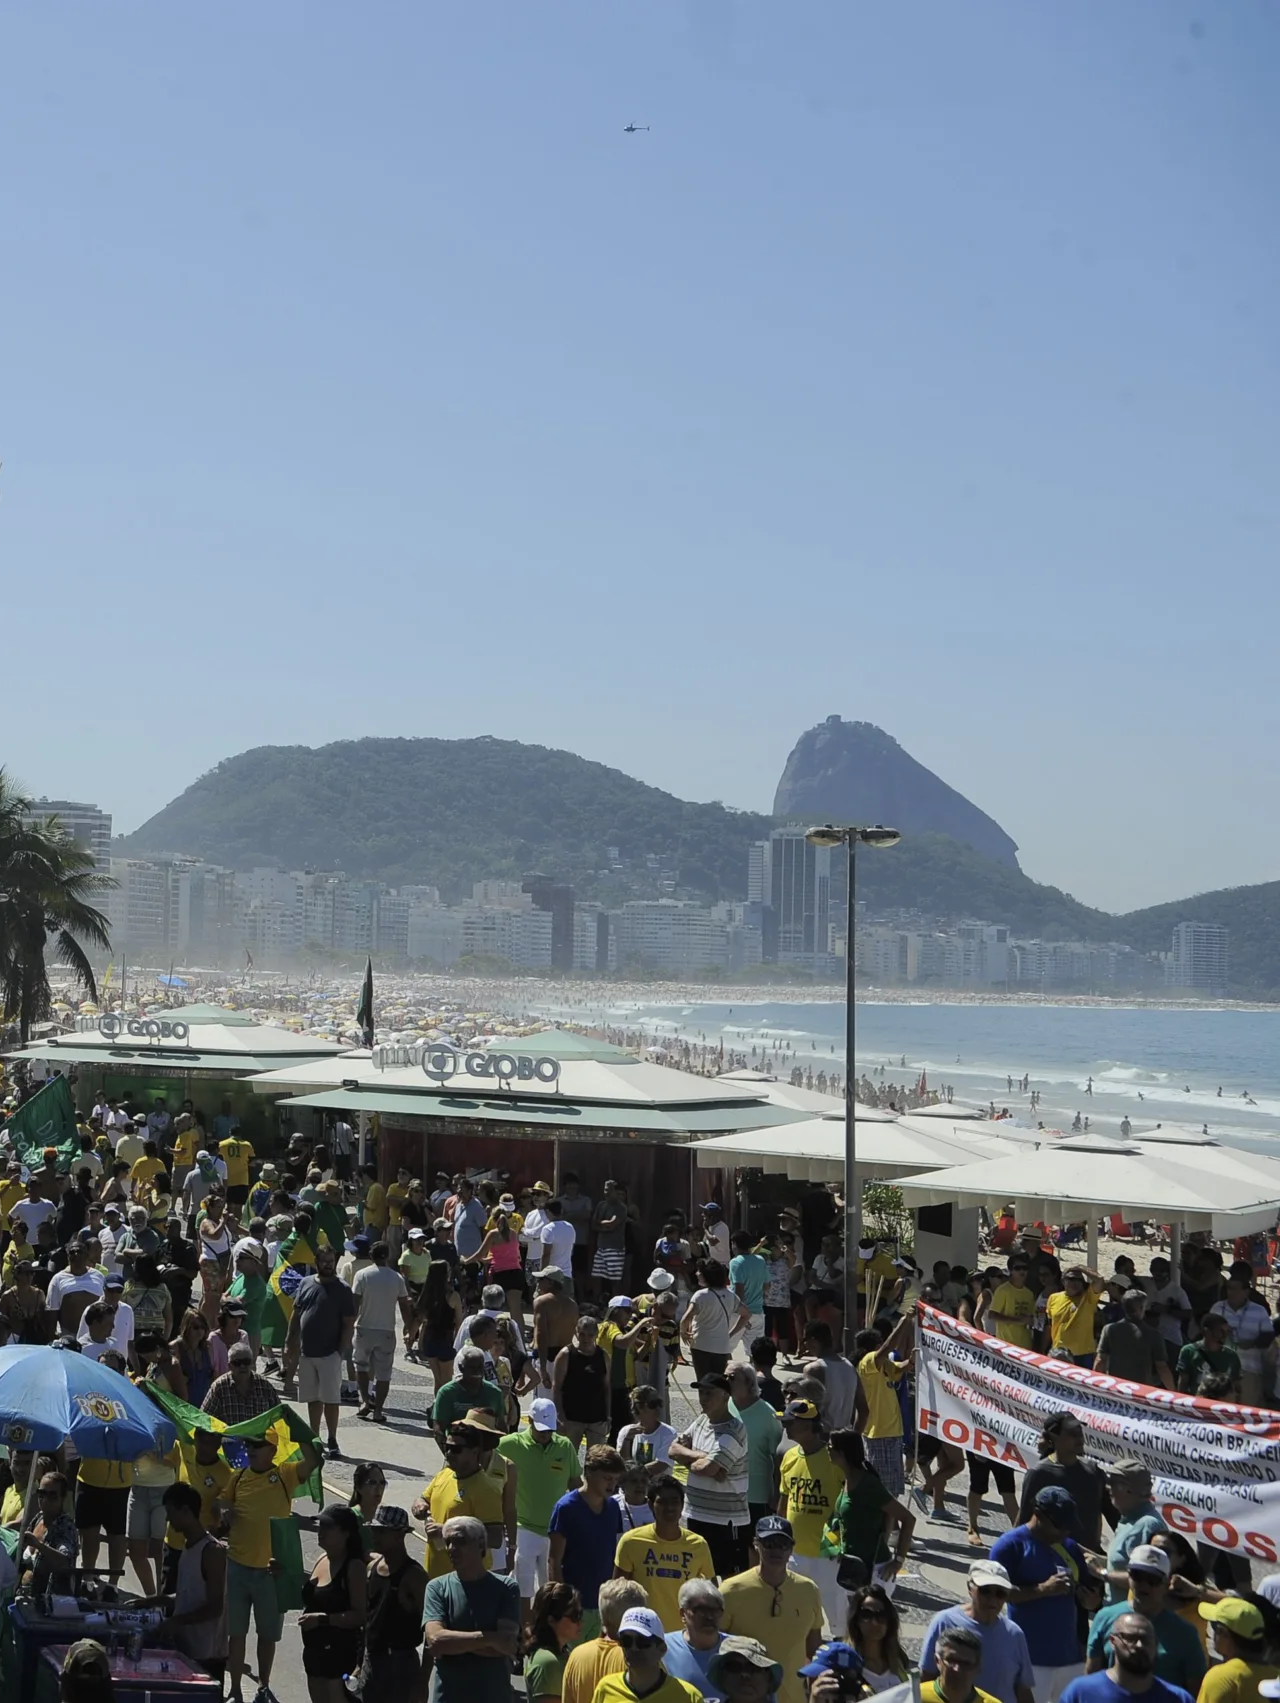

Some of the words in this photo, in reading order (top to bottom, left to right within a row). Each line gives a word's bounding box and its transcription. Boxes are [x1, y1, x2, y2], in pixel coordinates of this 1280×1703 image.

[127, 1019, 188, 1040] GLOBO
[465, 1052, 559, 1083] GLOBO
[922, 1334, 970, 1362] BURGUESES
[971, 1350, 989, 1369] SÃO
[1023, 1371, 1042, 1388] QUE
[1149, 1411, 1223, 1448] TRABALHADOR
[1227, 1434, 1280, 1463] BRASILEI
[940, 1379, 970, 1401] GOLPE
[970, 1391, 1006, 1415] CONTRA
[1084, 1432, 1125, 1460] UGANDO
[1144, 1453, 1202, 1484] RIQUEZAS
[1202, 1472, 1220, 1488] DO
[944, 1362, 952, 1375] O
[952, 1364, 971, 1381] LULA
[971, 1374, 989, 1391] QUE
[990, 1380, 1002, 1396] OS
[1122, 1425, 1130, 1440] E
[1131, 1430, 1191, 1460] CONTINUA
[1190, 1449, 1263, 1481] CHEFIANDO
[1265, 1467, 1276, 1482] O
[1210, 1403, 1280, 1433] CU
[970, 1408, 987, 1428] NÓS
[988, 1418, 1009, 1438] AQUI
[1156, 1479, 1218, 1514] TRABALHO!
[790, 1477, 821, 1494] FORA
[919, 1407, 1029, 1470] FORA
[1160, 1502, 1278, 1563] GOS
[643, 1548, 658, 1565] A
[660, 1553, 679, 1563] AND
[681, 1551, 693, 1569] F
[646, 1566, 654, 1577] N
